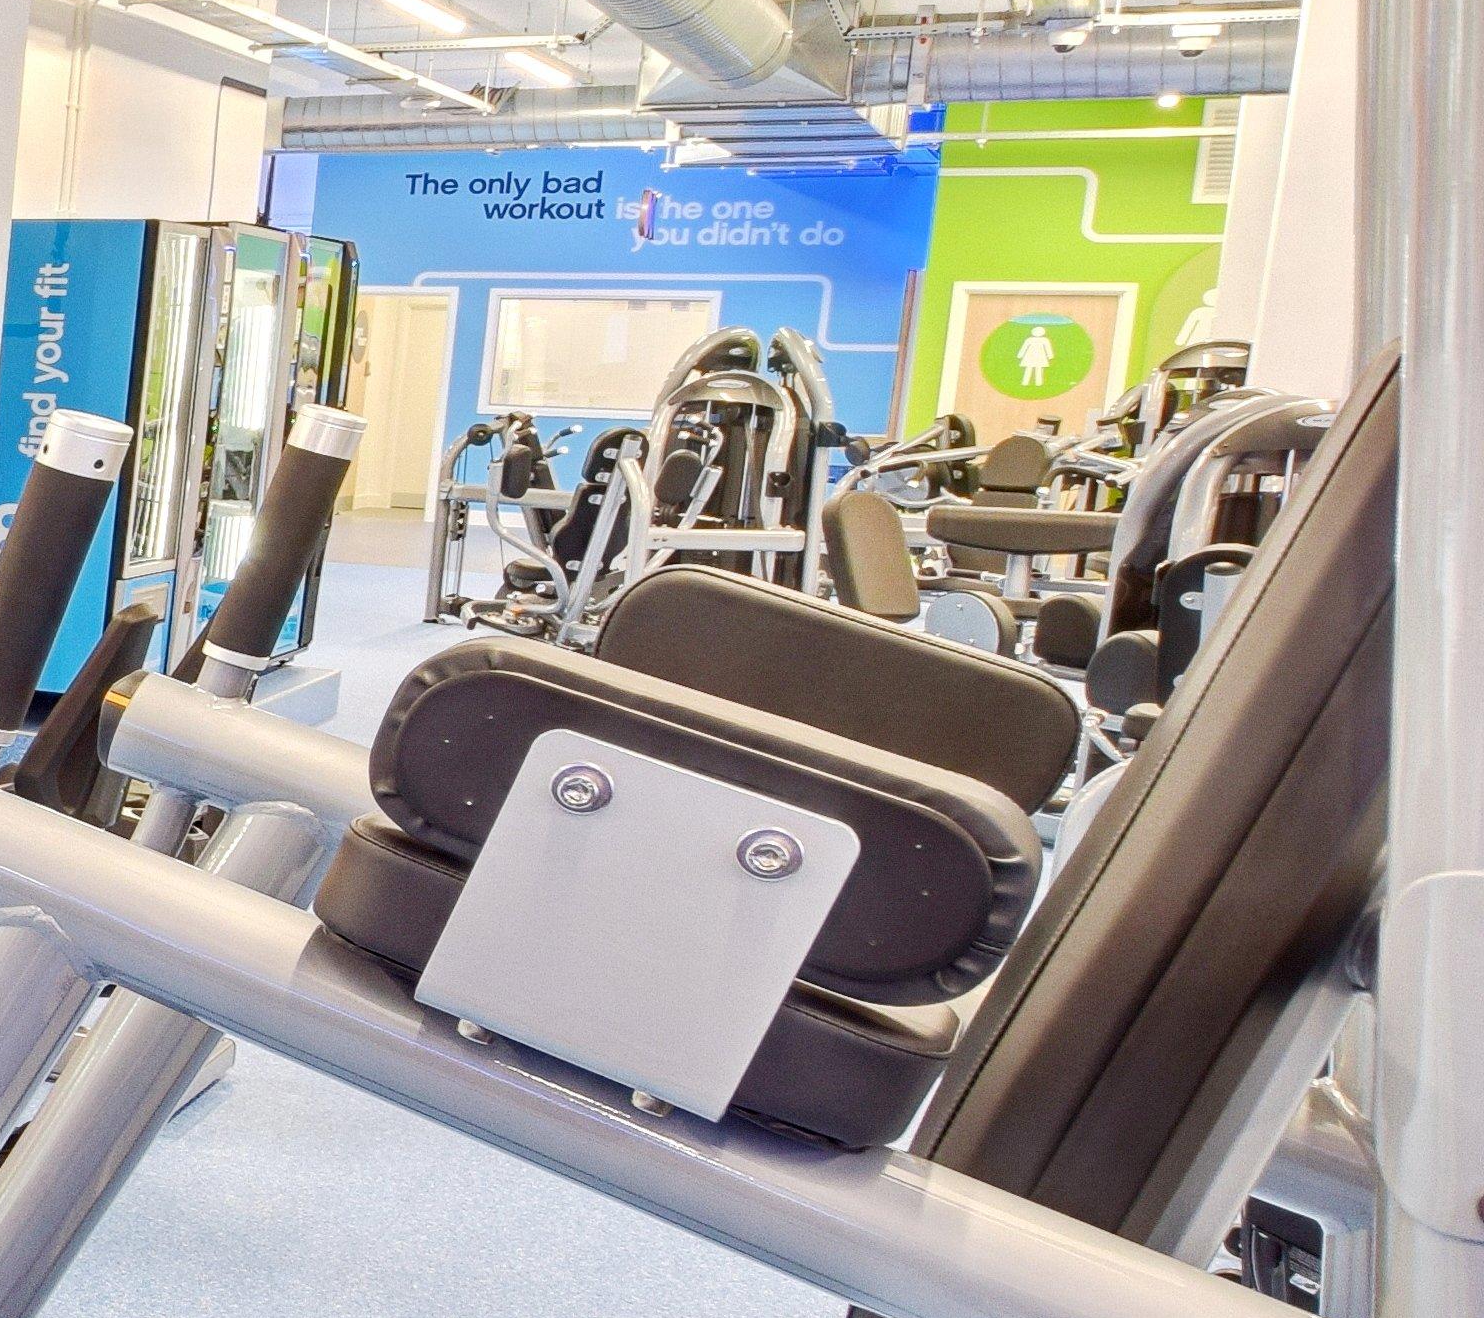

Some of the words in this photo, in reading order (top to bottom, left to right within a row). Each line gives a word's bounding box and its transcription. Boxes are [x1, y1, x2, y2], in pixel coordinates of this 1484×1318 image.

[405, 173, 459, 195] The
[468, 171, 538, 201] only
[542, 170, 603, 195] bad
[483, 197, 606, 220] workout
[654, 195, 703, 220] he
[711, 199, 775, 220] one
[799, 220, 845, 246] do
[32, 262, 70, 298] fit
[33, 305, 70, 383] your
